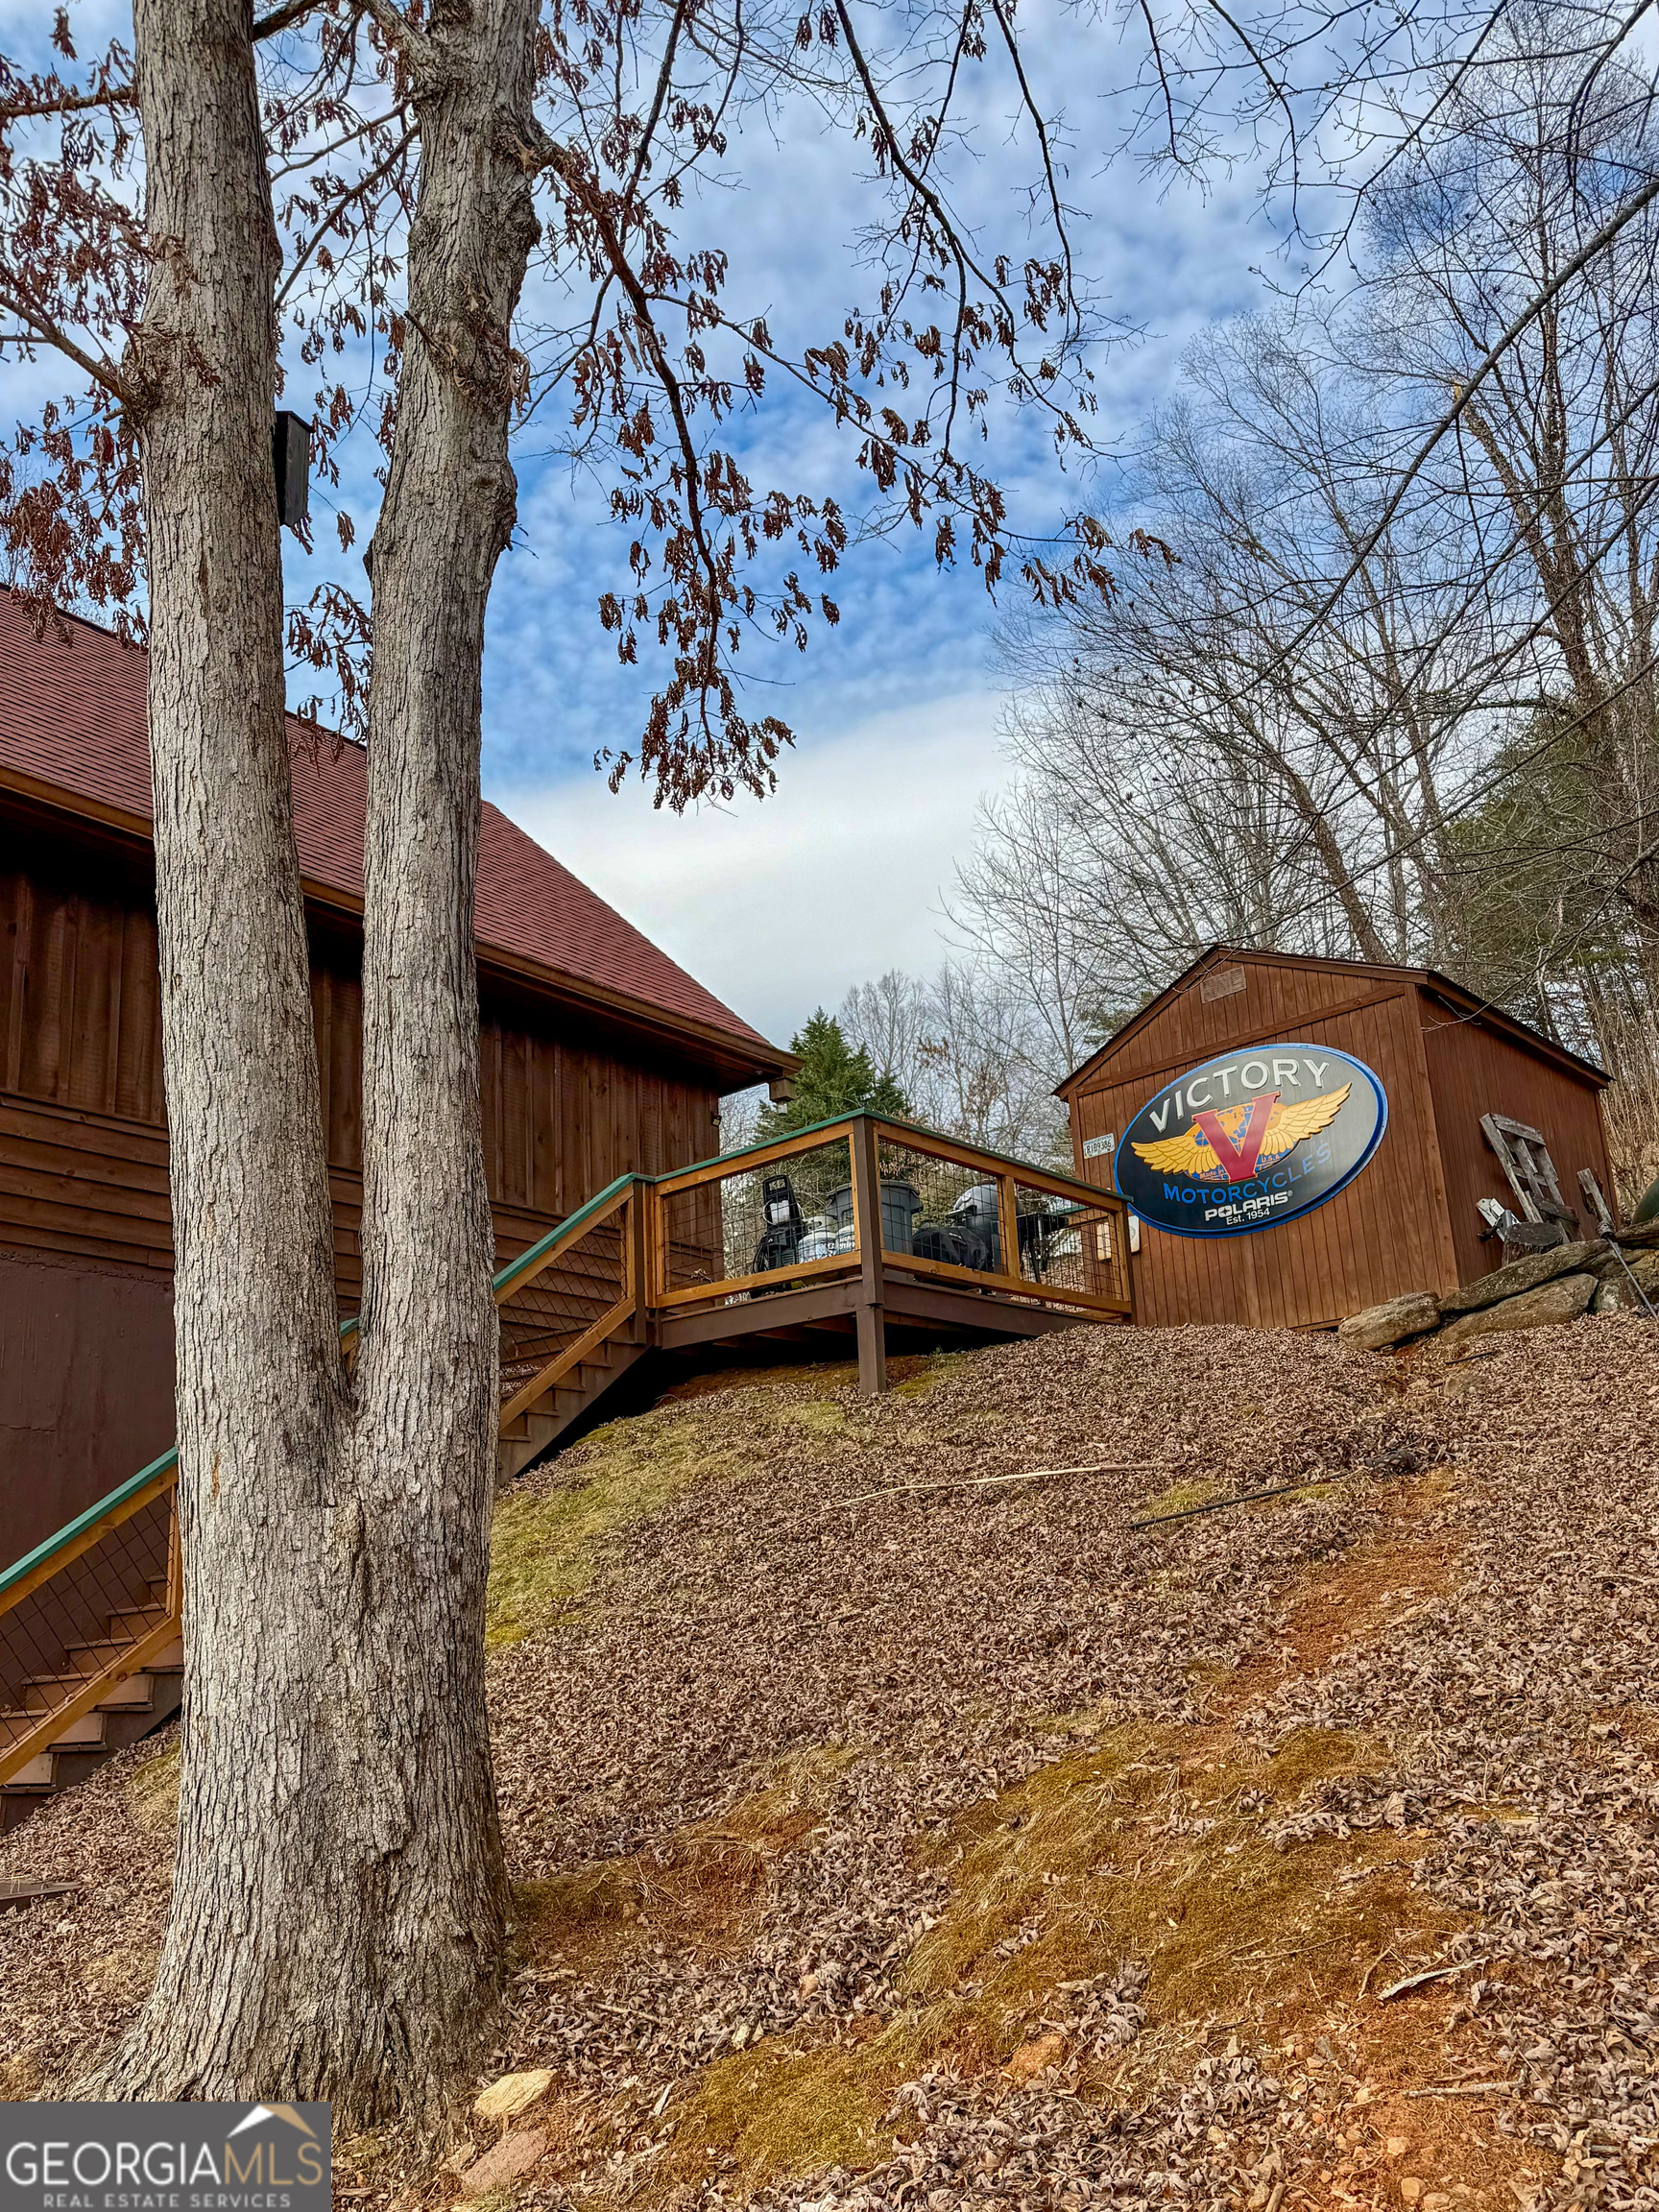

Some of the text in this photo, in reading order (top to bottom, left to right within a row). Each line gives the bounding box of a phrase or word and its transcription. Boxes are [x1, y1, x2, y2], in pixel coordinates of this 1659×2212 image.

[1149, 1058, 1330, 1133] VICTORY
[1191, 1091, 1281, 1184] V
[1163, 1142, 1332, 1205] MOTORCYCLES
[1226, 1207, 1271, 1226] Est. 1954
